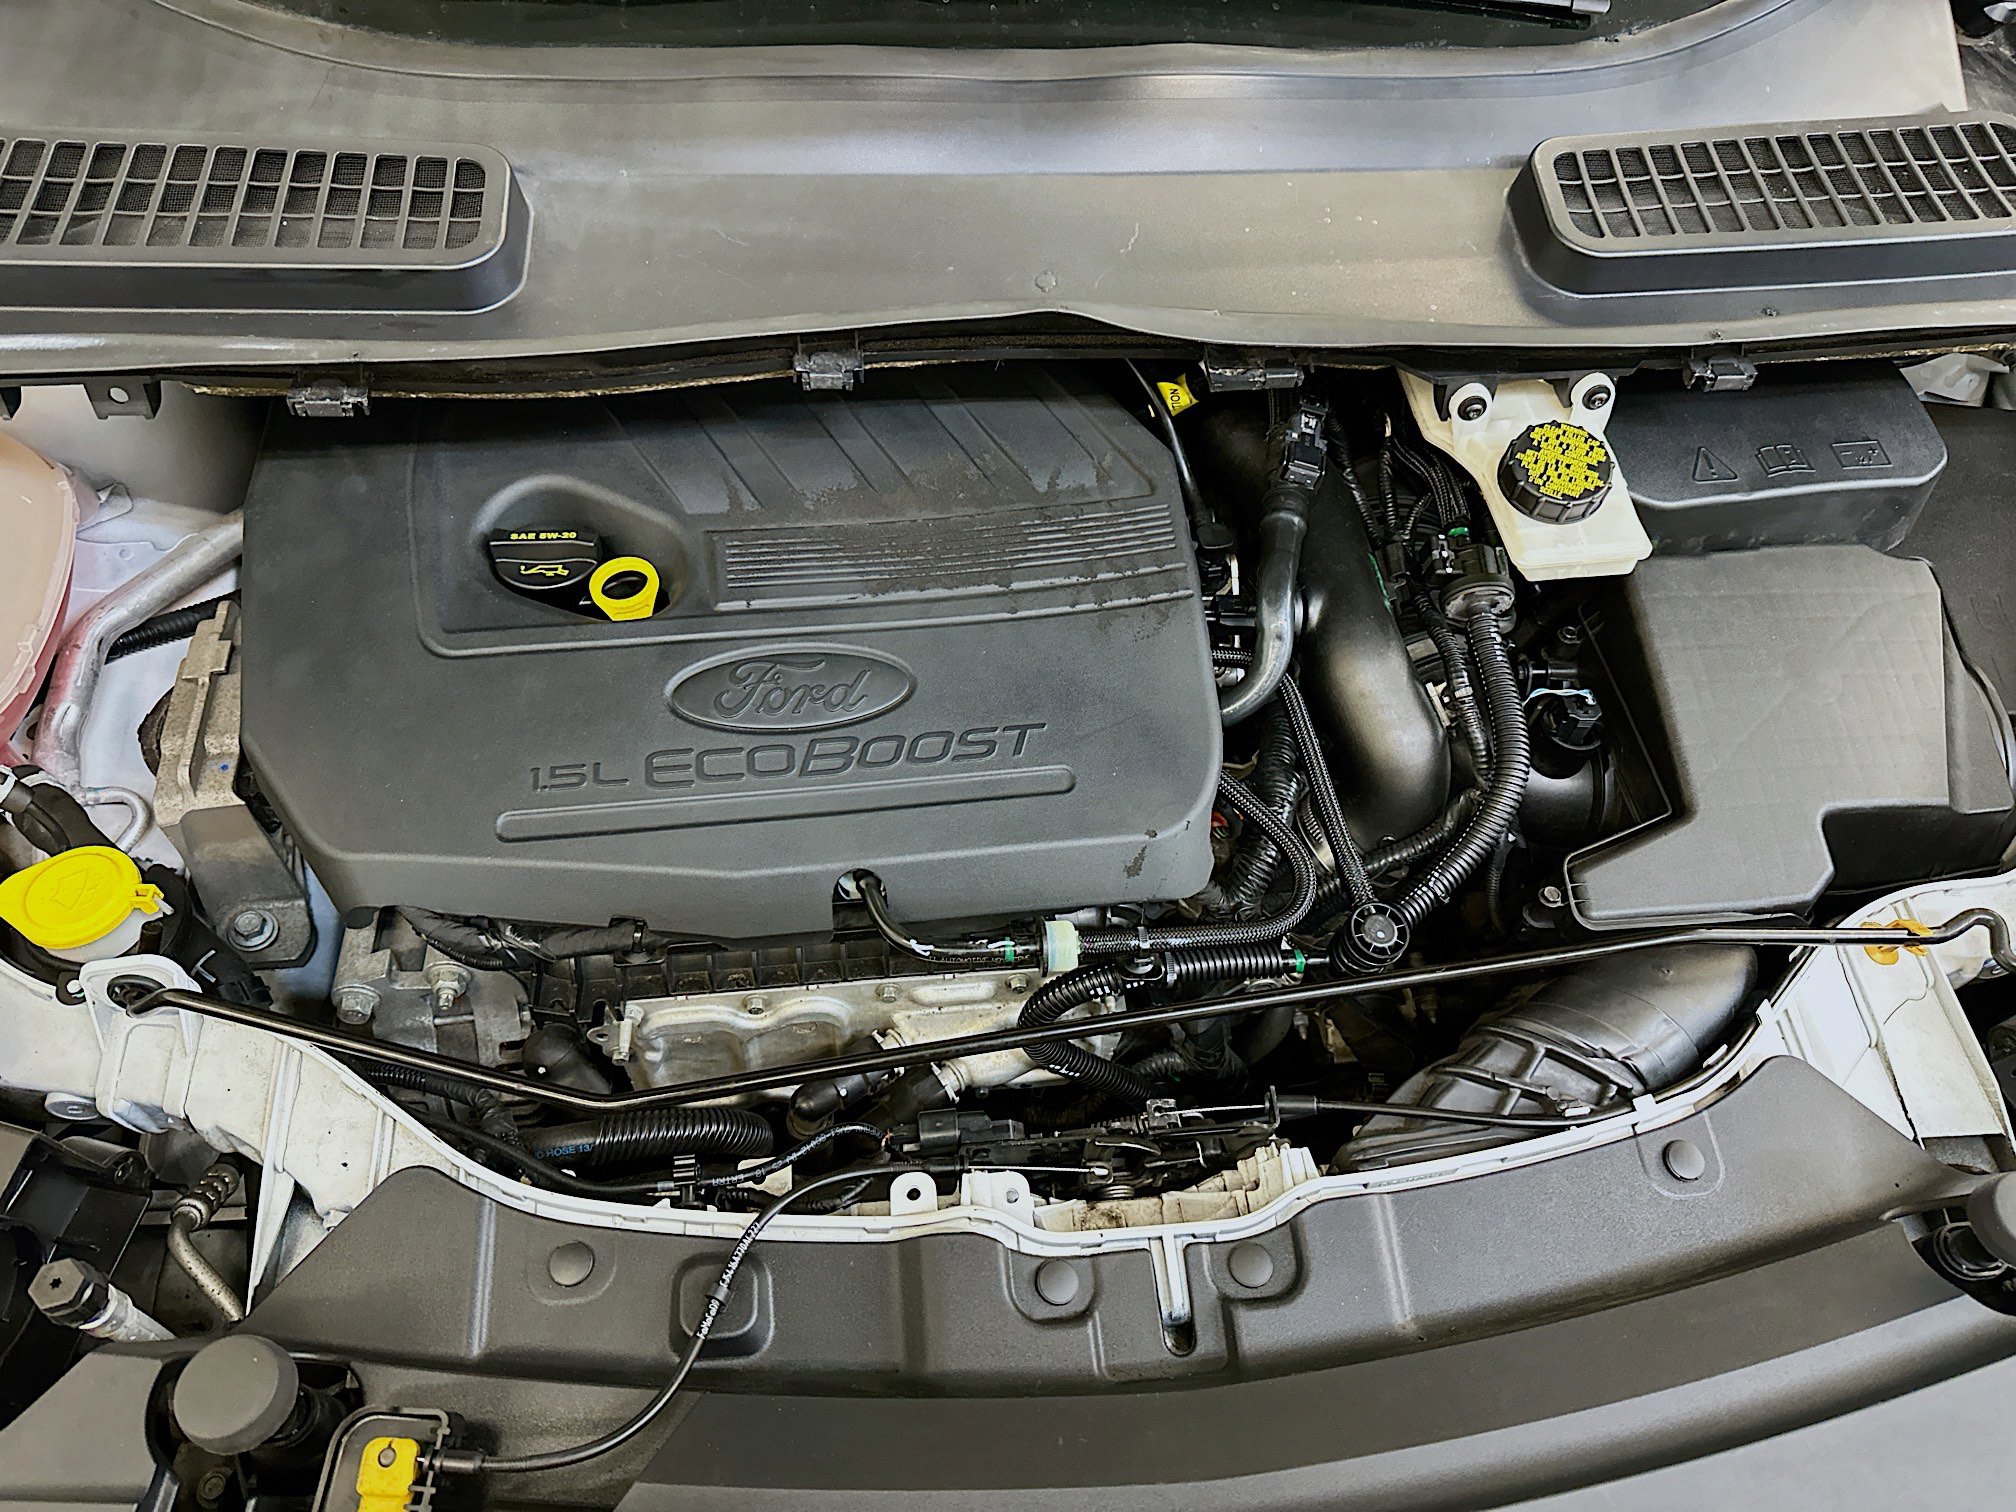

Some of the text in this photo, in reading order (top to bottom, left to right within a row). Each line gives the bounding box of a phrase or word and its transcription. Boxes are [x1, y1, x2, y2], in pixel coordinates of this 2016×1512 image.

[510, 532, 536, 540] SAE
[713, 658, 872, 718] Ford
[529, 761, 630, 792] 1.5L
[546, 1146, 576, 1157] HOSE
